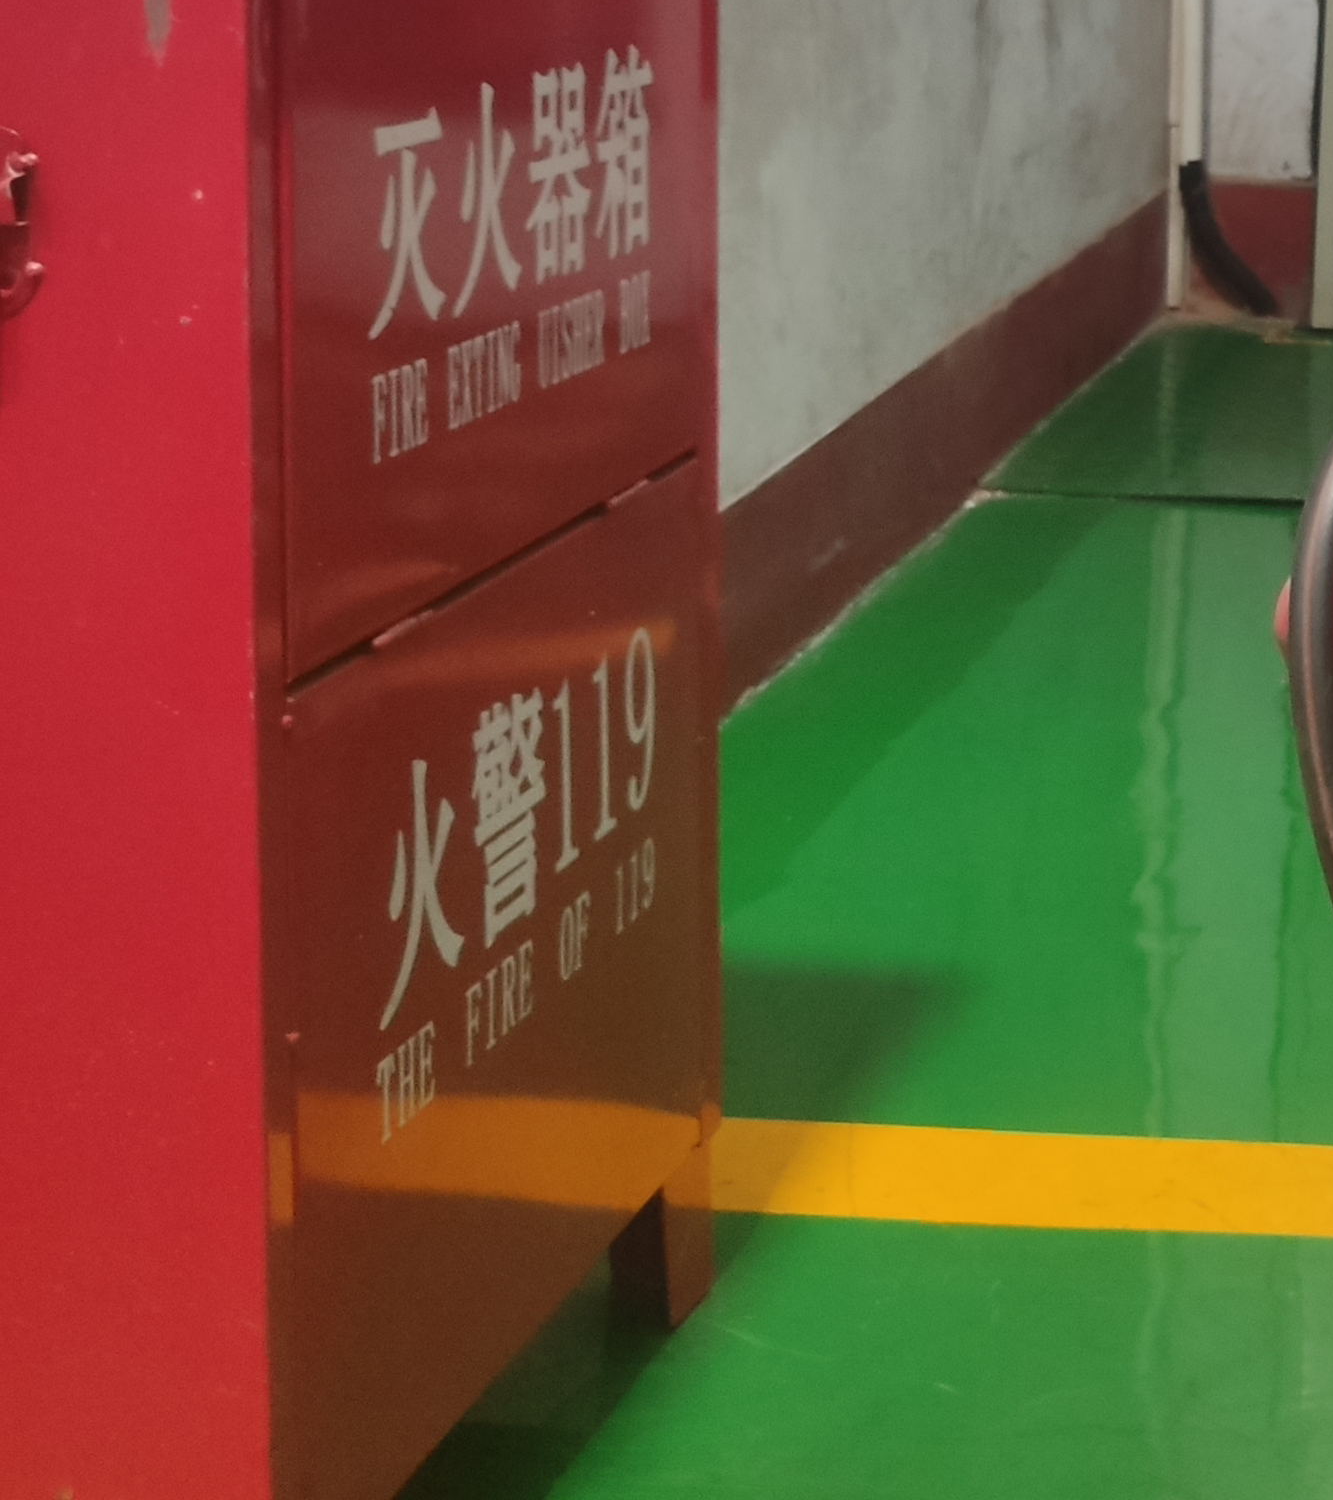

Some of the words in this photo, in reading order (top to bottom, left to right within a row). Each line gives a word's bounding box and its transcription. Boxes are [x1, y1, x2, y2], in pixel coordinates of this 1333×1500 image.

[367, 44, 654, 341] 灭火器箱
[371, 357, 429, 465] FIRE
[378, 626, 656, 1032] 火警119
[375, 1021, 436, 1145] THE
[466, 940, 534, 1067] FIRE
[559, 890, 591, 981] OF
[615, 837, 656, 935] 119
